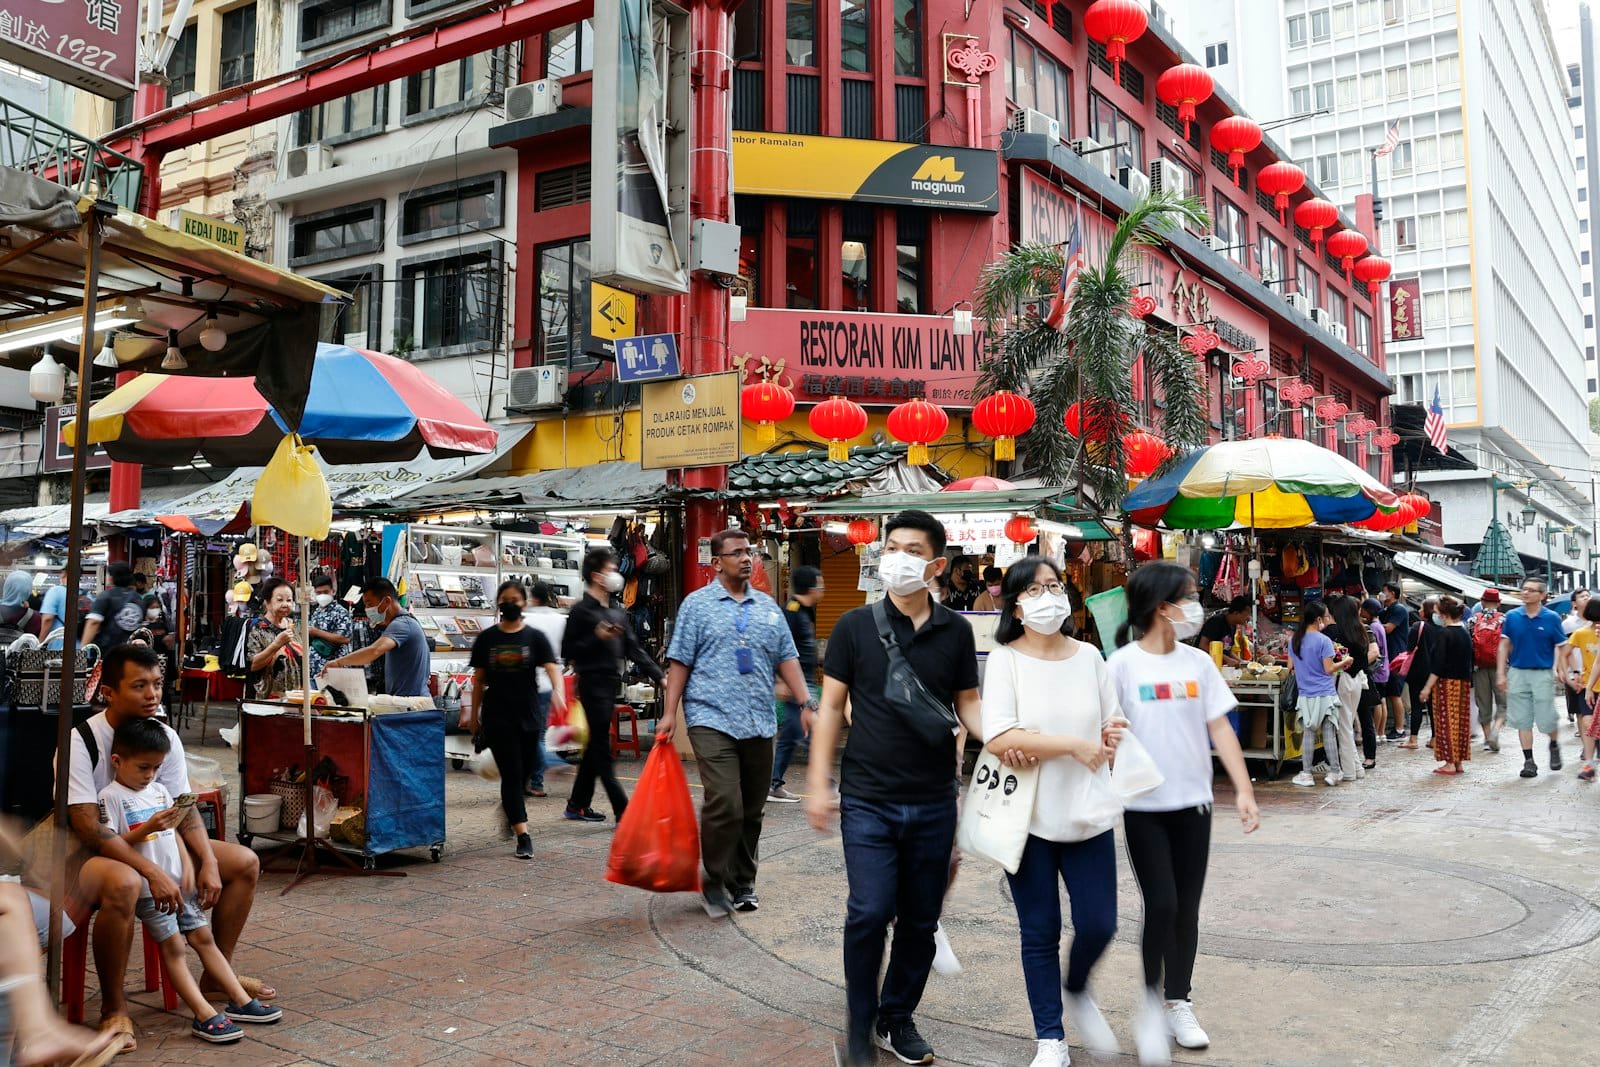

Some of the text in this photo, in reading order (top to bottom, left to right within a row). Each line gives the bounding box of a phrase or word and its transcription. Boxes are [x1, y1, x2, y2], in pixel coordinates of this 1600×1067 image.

[56, 34, 118, 72] 1927
[760, 137, 804, 147] Ramalan
[911, 181, 966, 195] magnum
[185, 217, 239, 246] KEDAI UBAT
[800, 320, 884, 368] RESTORAN
[892, 327, 922, 369] KIM
[930, 328, 965, 371] LIAN
[653, 406, 726, 423] DILARANG MENJUAL
[647, 421, 734, 438] PRODUK CETAK ROMPAK
